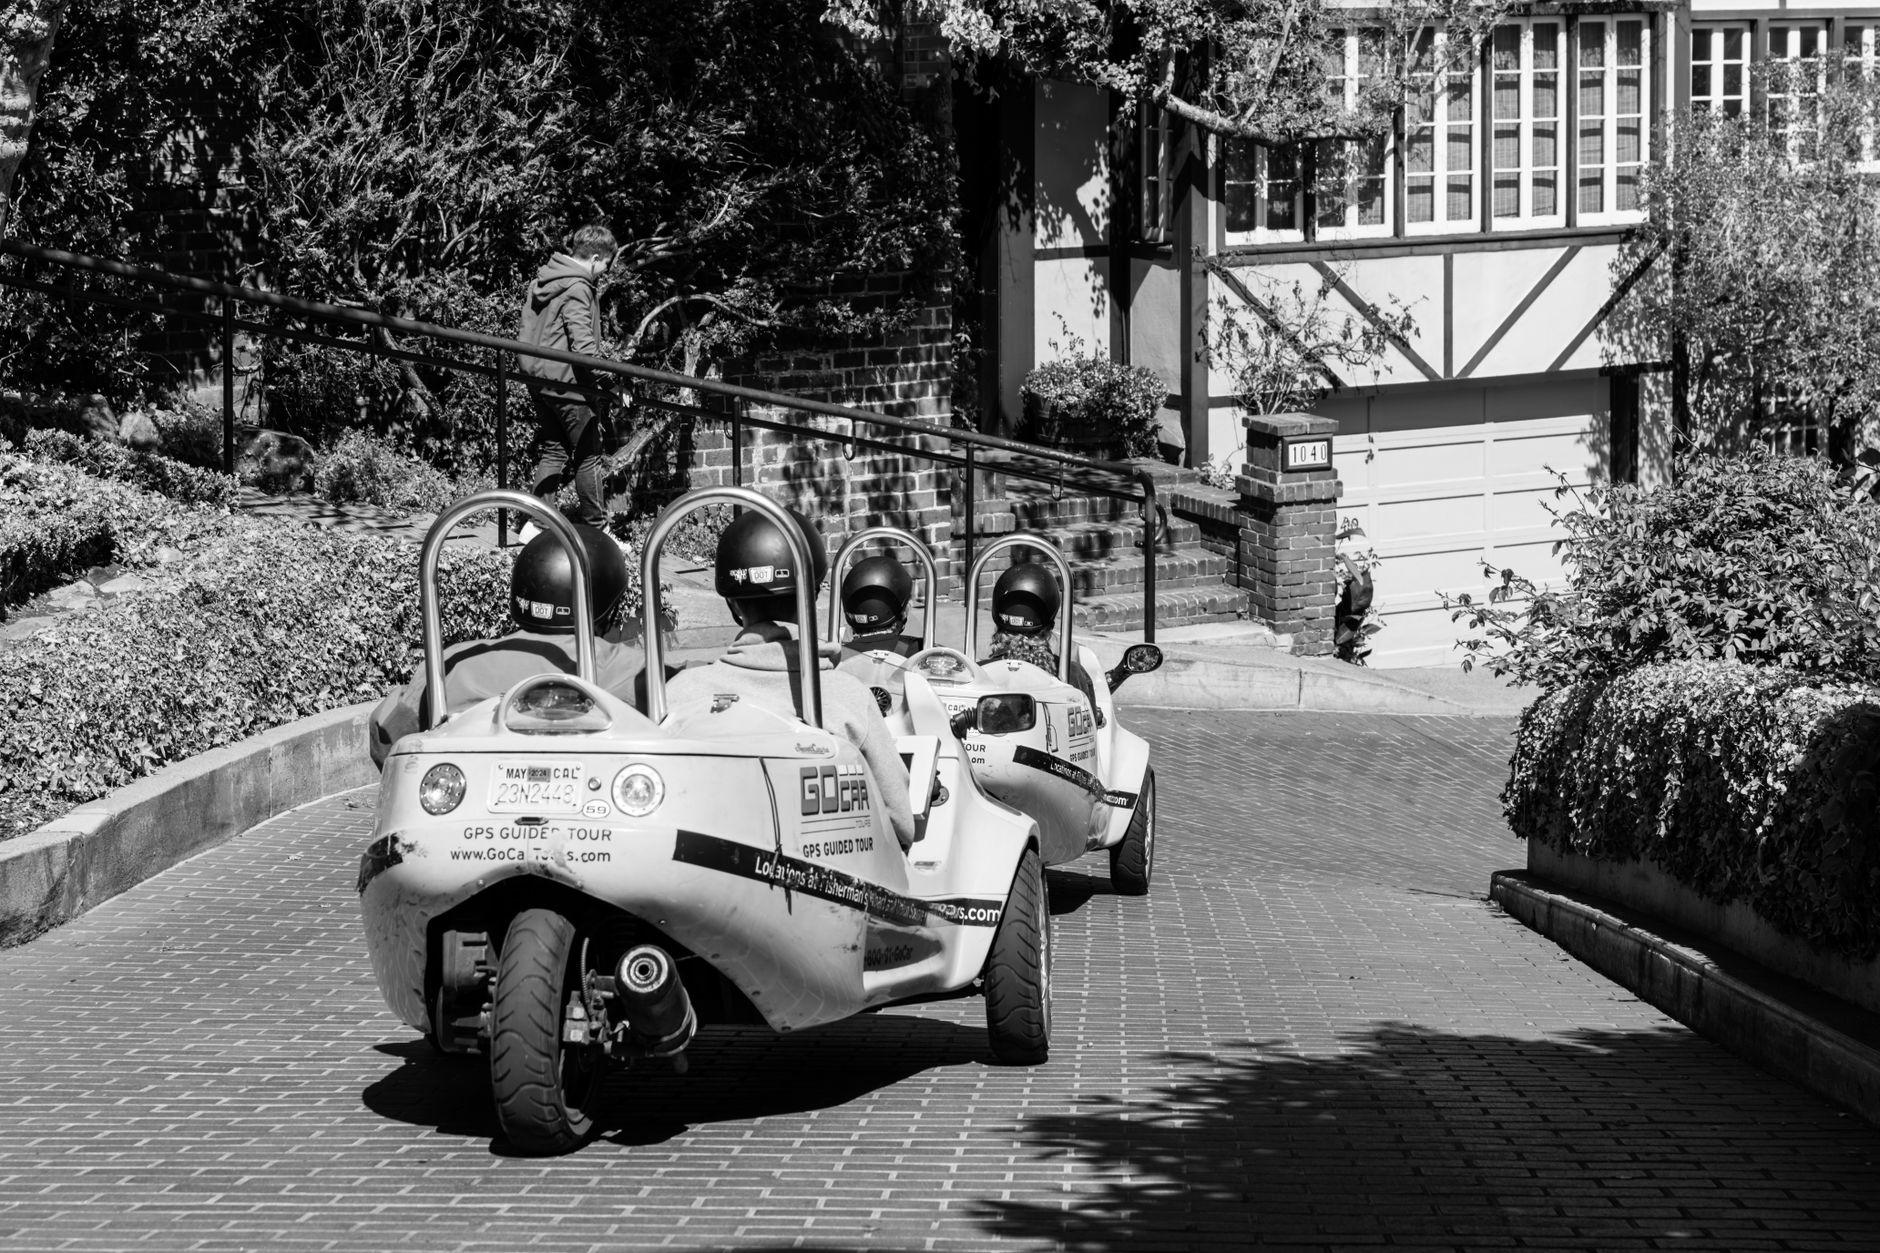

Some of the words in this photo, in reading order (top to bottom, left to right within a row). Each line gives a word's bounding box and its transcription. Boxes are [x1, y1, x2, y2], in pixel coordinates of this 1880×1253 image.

[1294, 443, 1327, 463] 1040
[963, 743, 986, 752] OUR
[506, 768, 527, 780] MAY
[553, 768, 578, 780] CAL
[497, 782, 575, 804] 23N2448
[585, 805, 607, 815] 59
[464, 827, 495, 840] GPS
[567, 828, 613, 841] TOUR
[803, 843, 821, 859] GPS
[823, 839, 855, 857] GUIDED
[855, 836, 874, 853] TOUR
